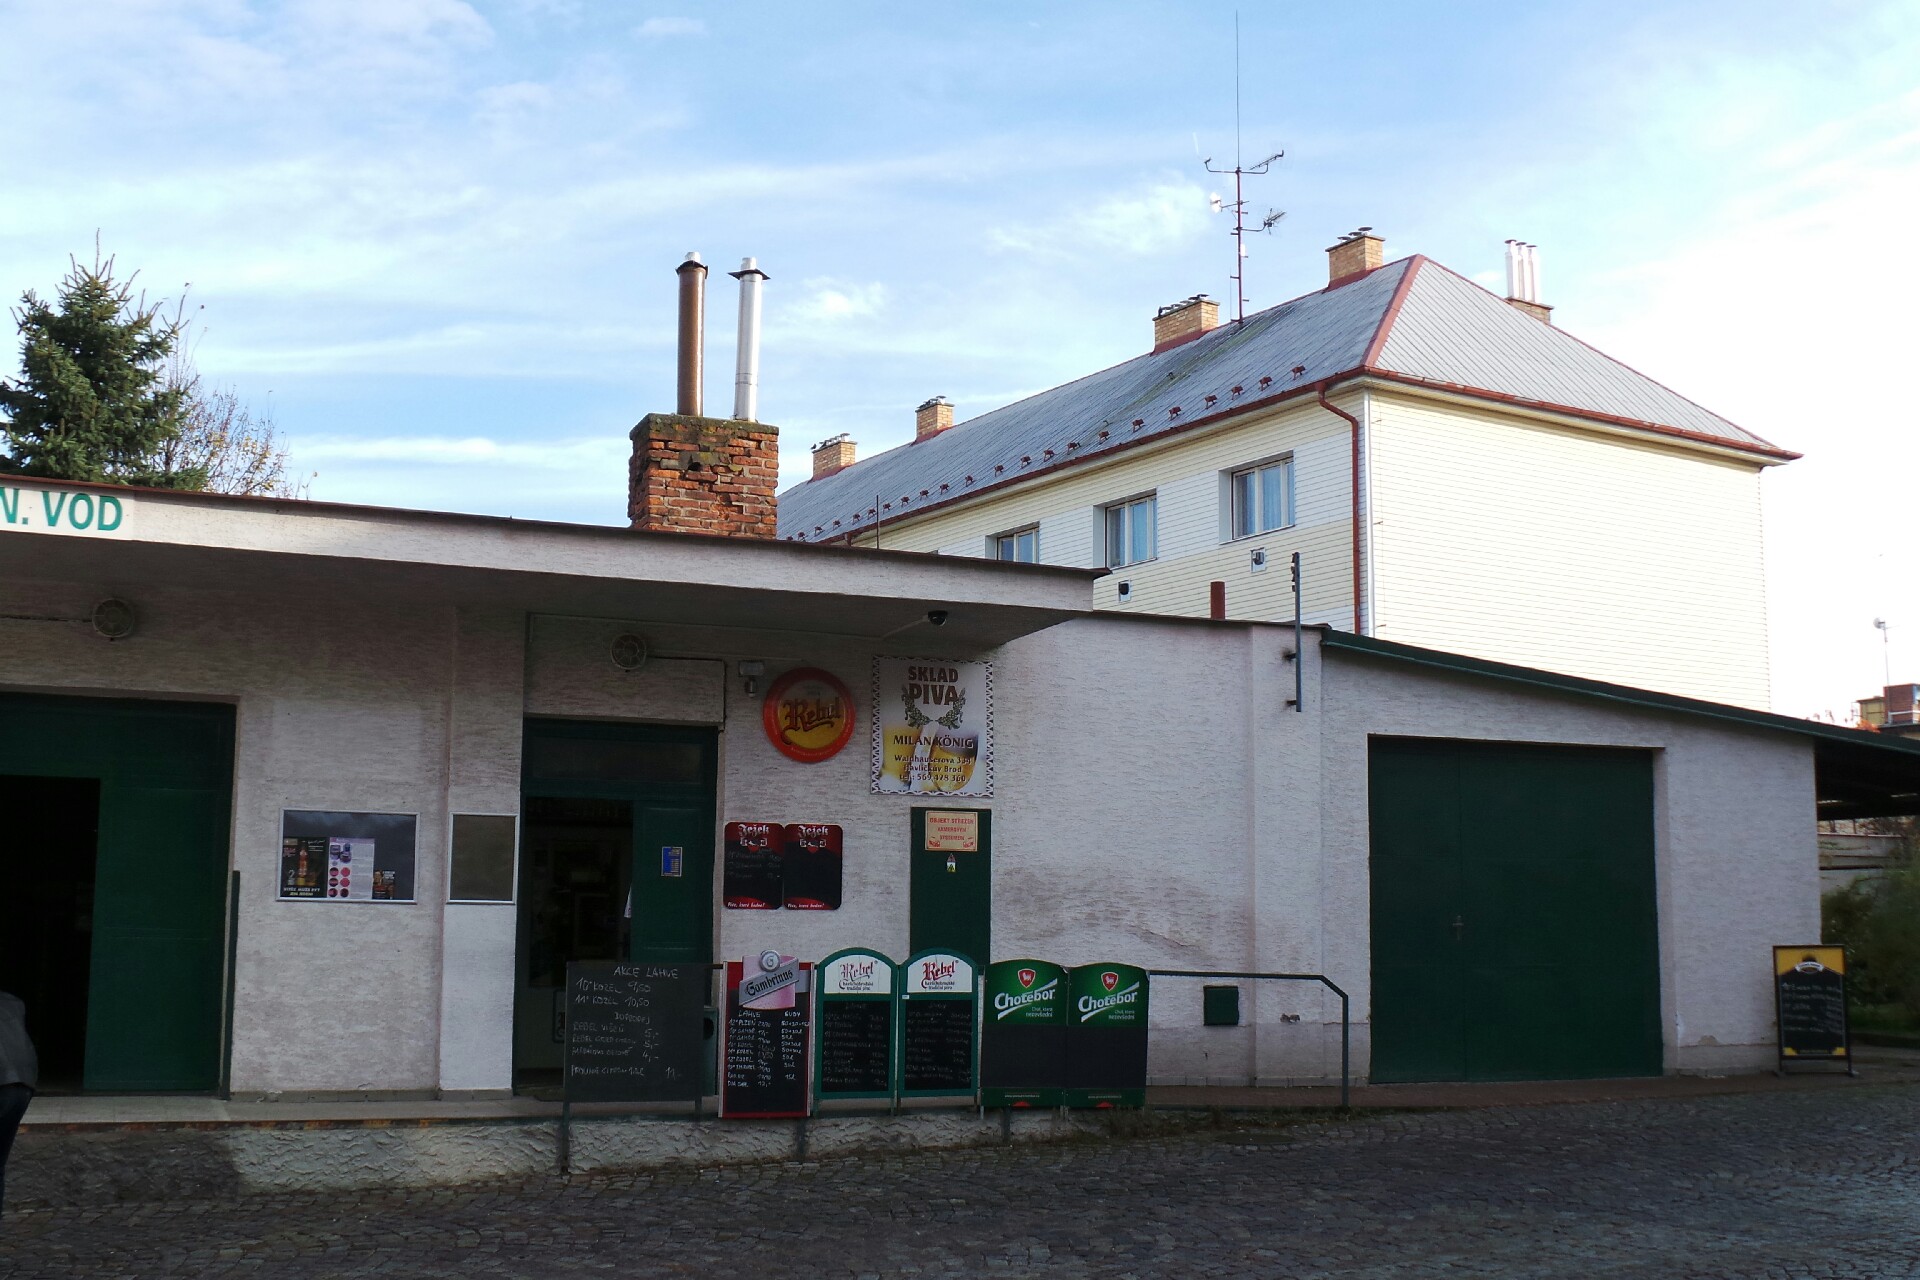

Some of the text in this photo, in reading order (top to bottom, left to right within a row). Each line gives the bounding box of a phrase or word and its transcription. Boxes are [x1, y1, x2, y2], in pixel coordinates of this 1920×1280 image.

[42, 490, 123, 531] VOD
[908, 666, 959, 683] SKLAD
[908, 683, 958, 706] PIVA
[782, 694, 841, 738] Rebel
[893, 735, 974, 748] MILAN KÖNIG
[944, 765, 962, 773] Brod
[613, 966, 679, 979] AKCE LAHVE
[840, 961, 874, 981] Rebel
[922, 960, 957, 981] Rebel
[593, 981, 622, 994] KOZEL
[746, 969, 793, 996] Gambrinus
[592, 995, 619, 1005] KOZEL
